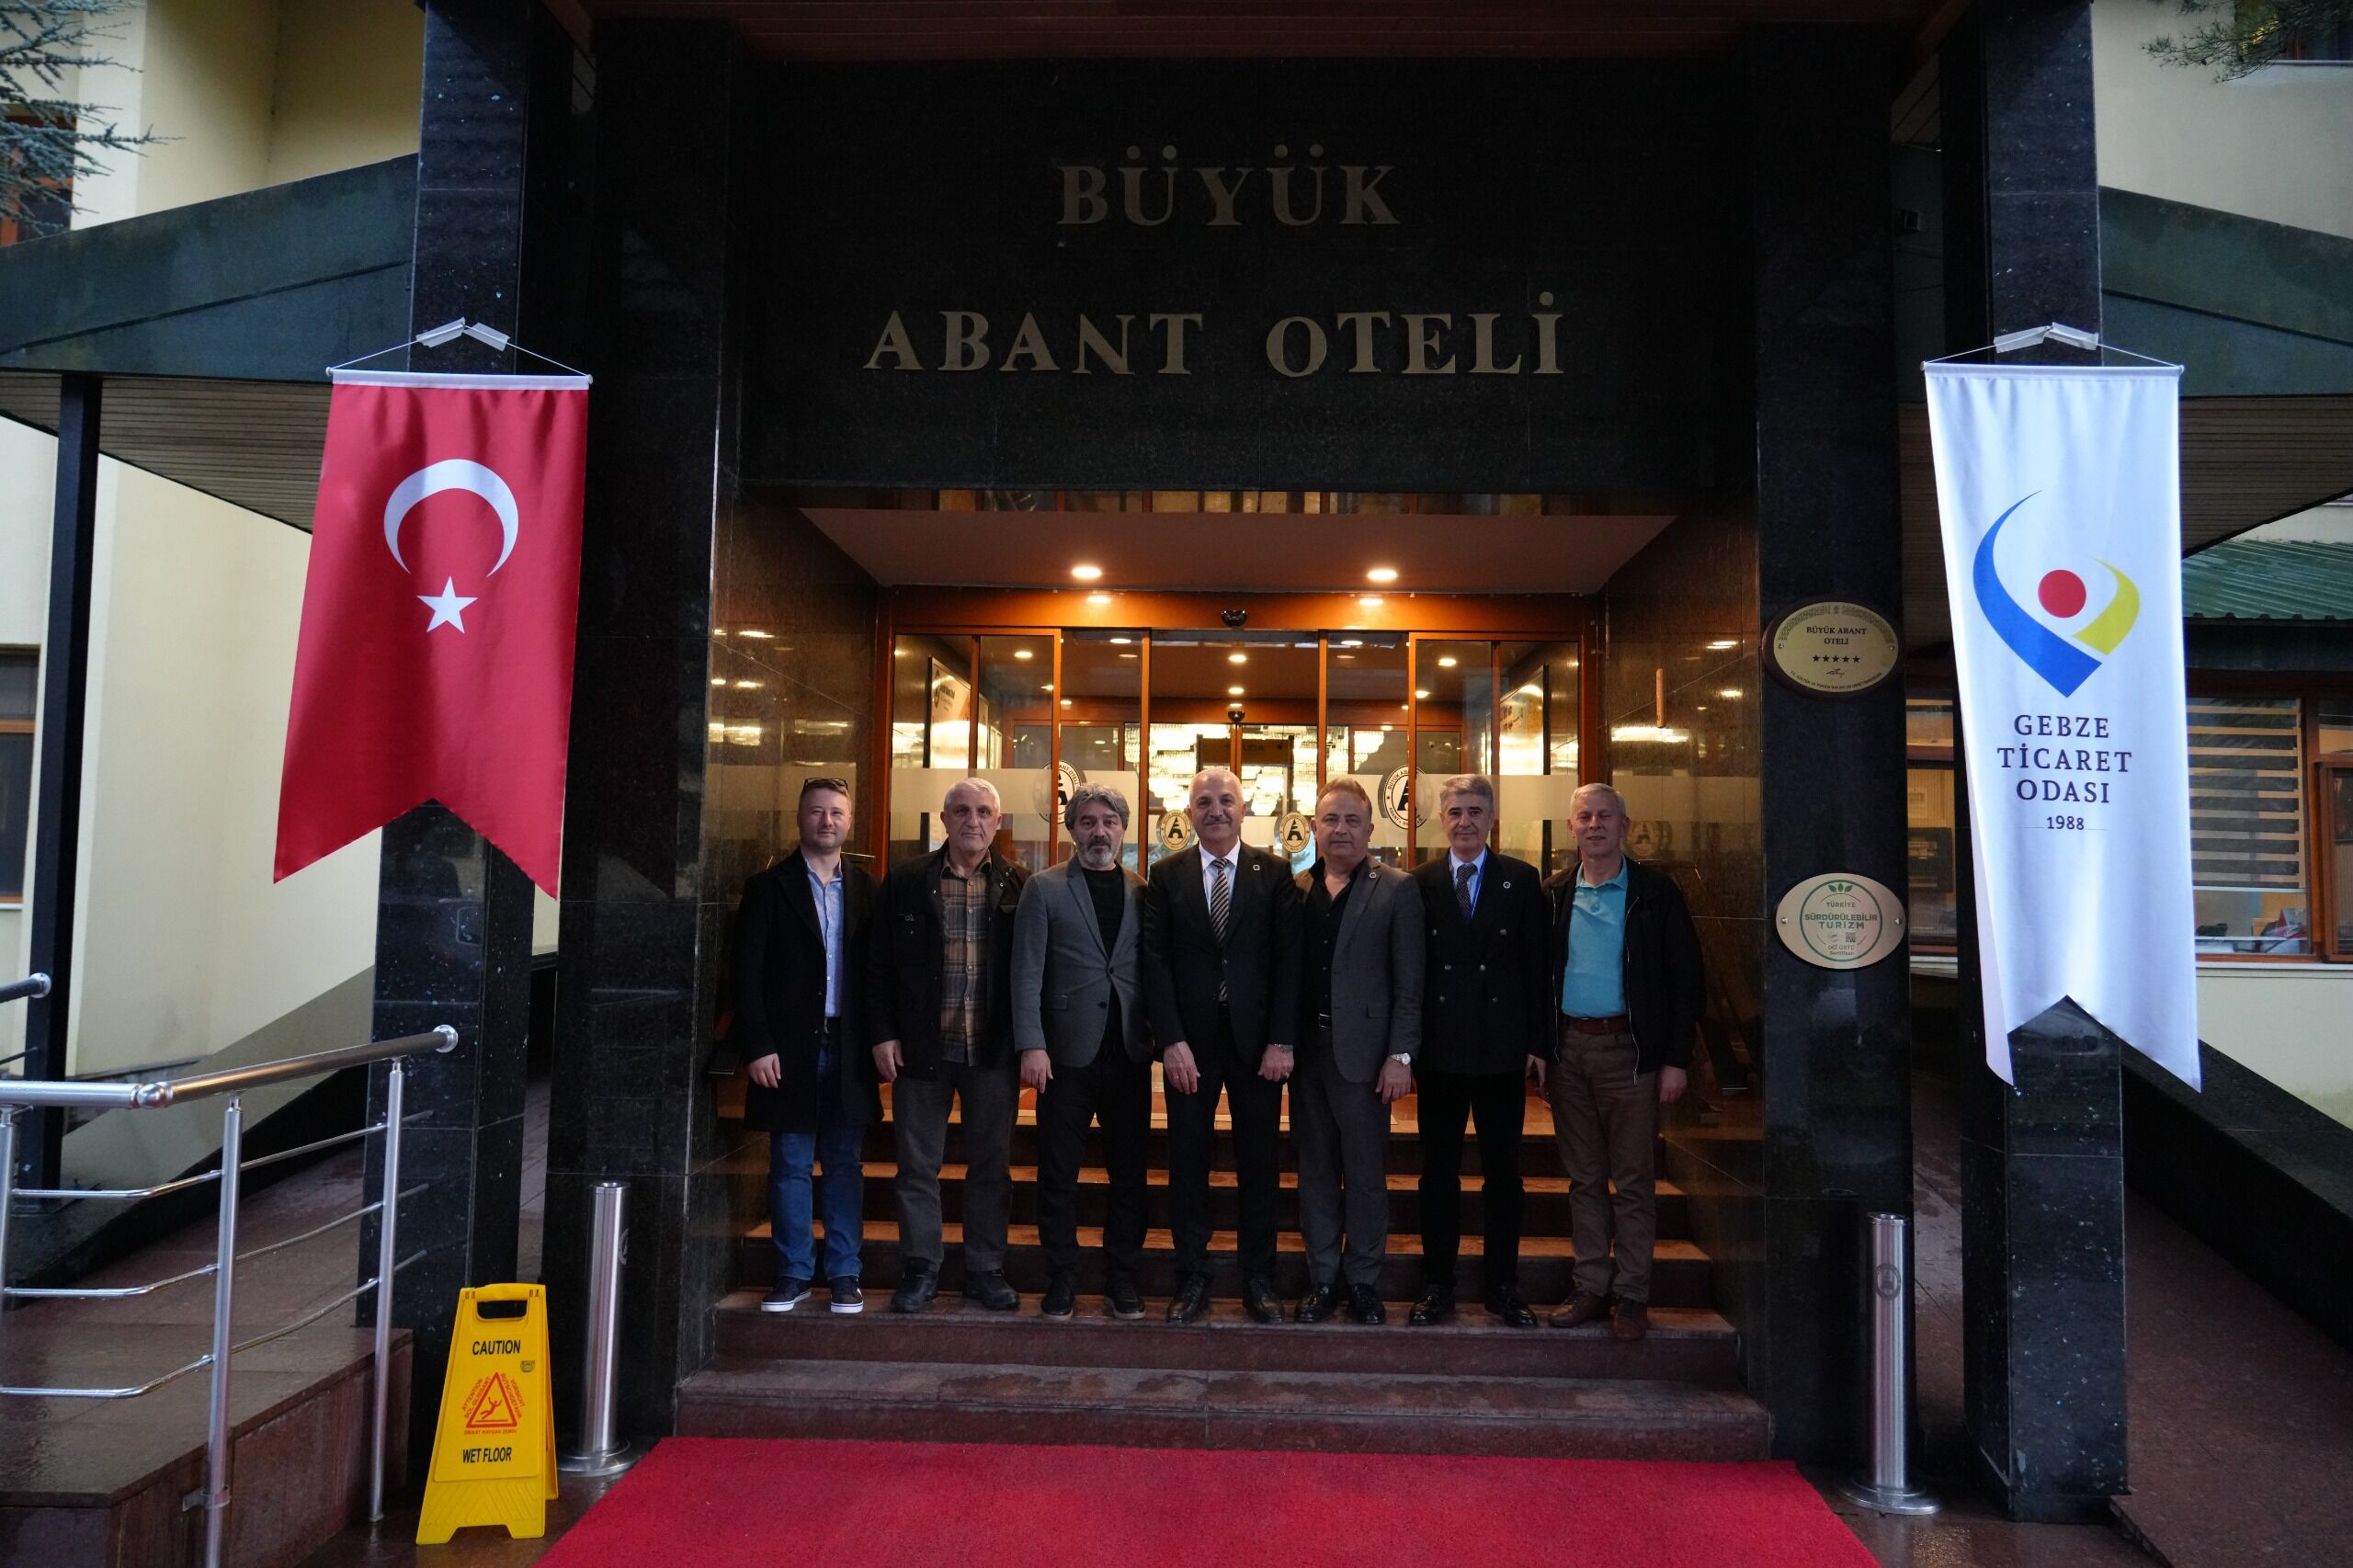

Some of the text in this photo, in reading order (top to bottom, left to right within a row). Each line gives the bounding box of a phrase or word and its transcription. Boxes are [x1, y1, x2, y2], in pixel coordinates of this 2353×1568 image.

[1055, 142, 1400, 227] BÜYÜK
[862, 290, 1565, 378] ABANT OTELİ
[1806, 625, 1868, 635] BÜYÜK ABANT
[2013, 714, 2110, 738] GEBZE
[1996, 743, 2132, 773] TİCARET
[2016, 778, 2110, 803] ODASI
[2046, 815, 2085, 831] 1988
[1804, 913, 1878, 921] SÜRDÜRÜLEBİLİR
[1818, 921, 1865, 929] TURİZM
[472, 1339, 521, 1356] CAUTION
[461, 1378, 483, 1412] ATTENTION
[462, 1447, 512, 1463] WET FLOOR
